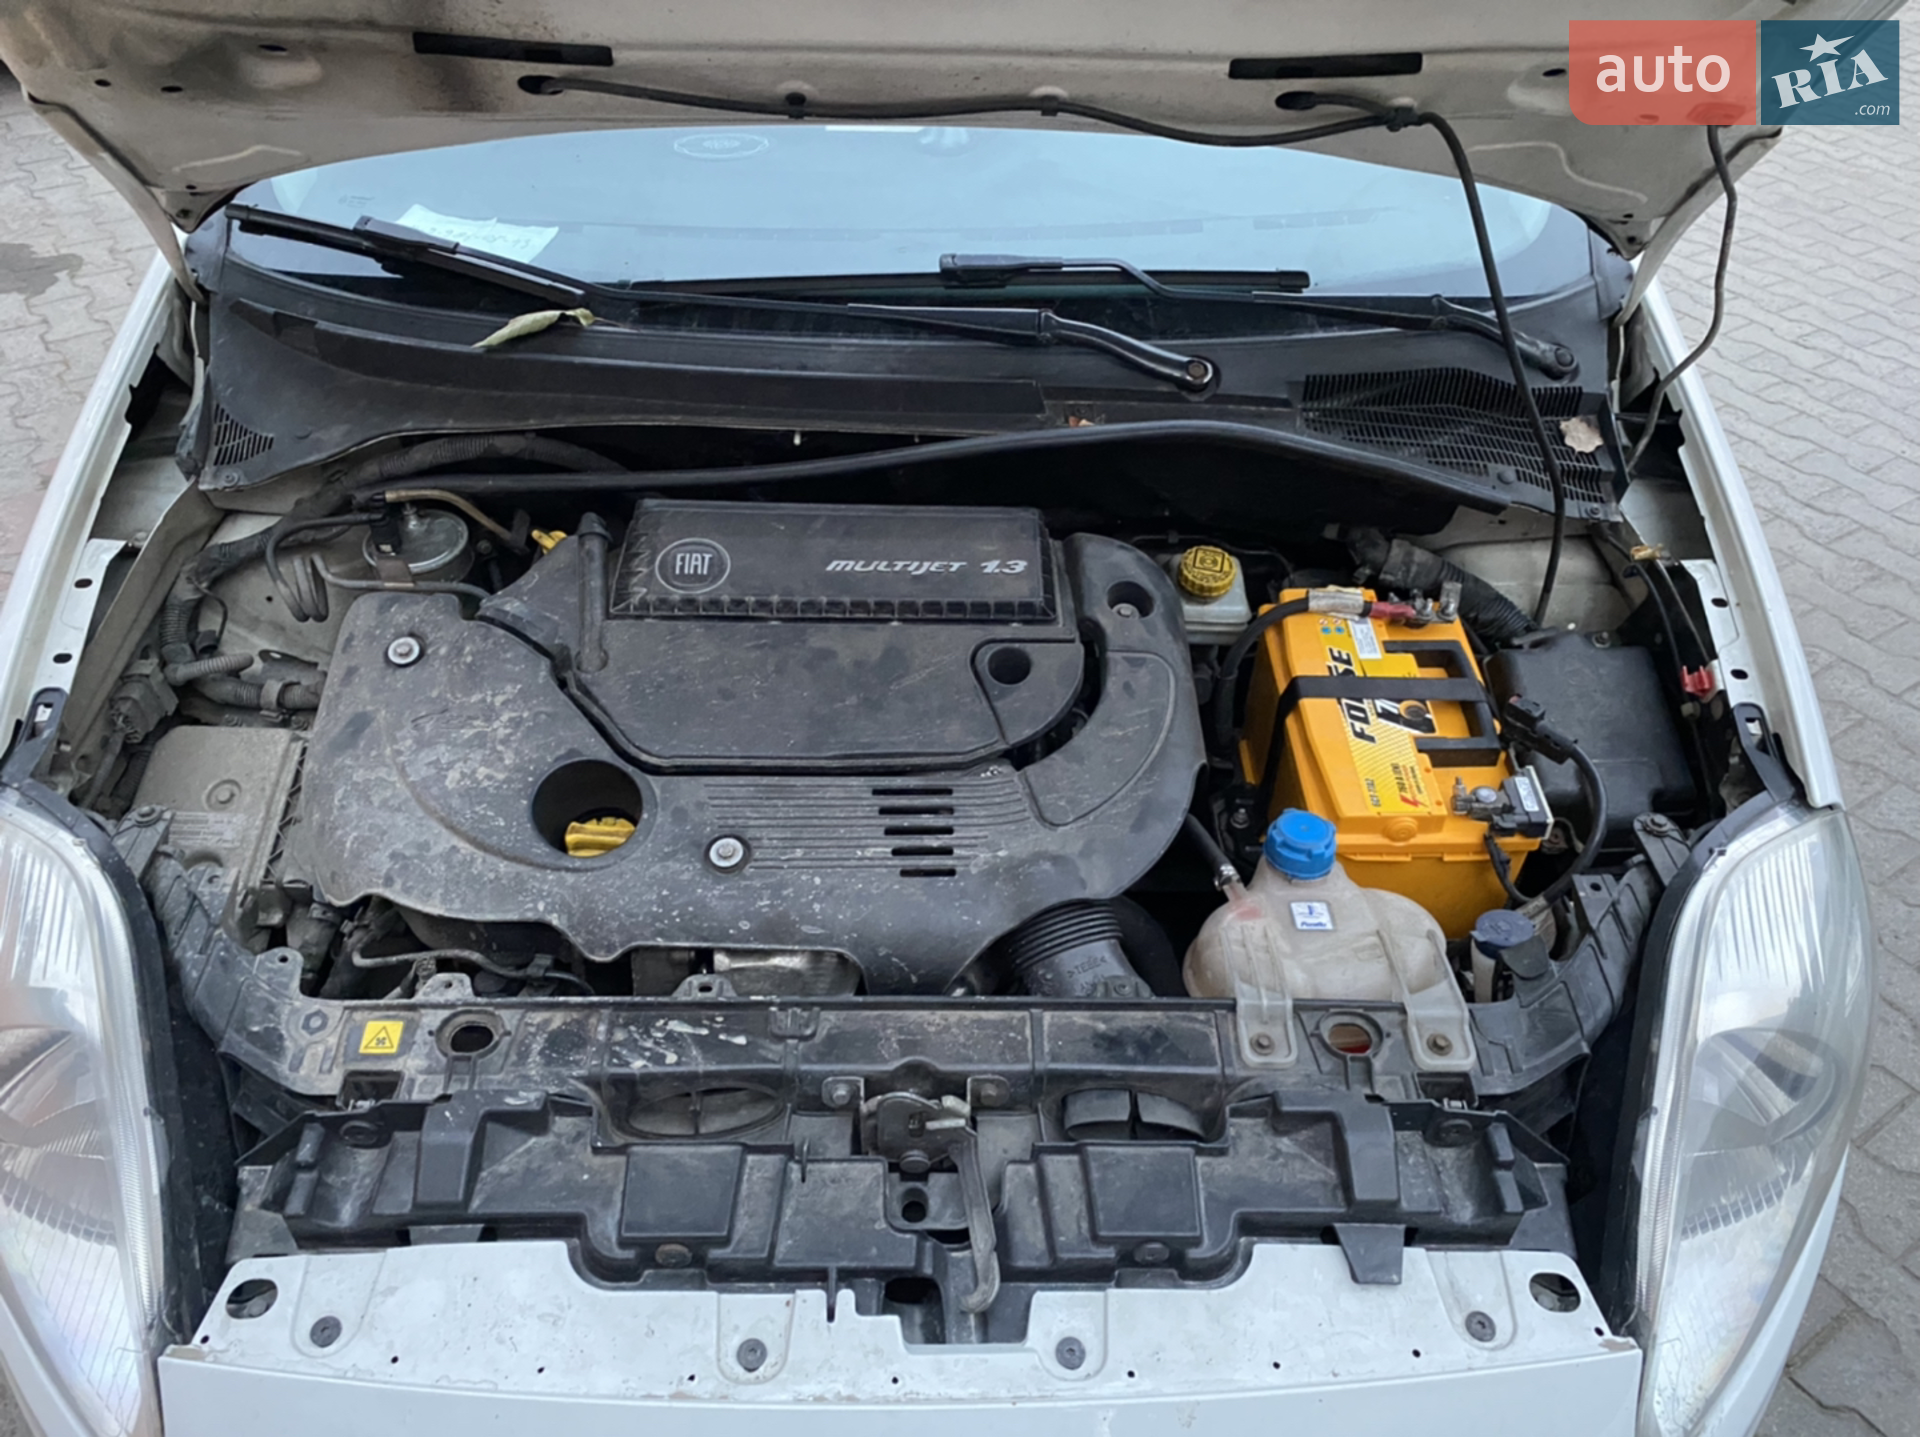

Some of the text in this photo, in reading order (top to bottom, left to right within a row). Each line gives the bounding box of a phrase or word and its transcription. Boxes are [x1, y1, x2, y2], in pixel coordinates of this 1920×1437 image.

[675, 553, 713, 575] FIAT
[826, 559, 1028, 576] MULTIJET 1.3
[1329, 647, 1377, 744] FOSE
